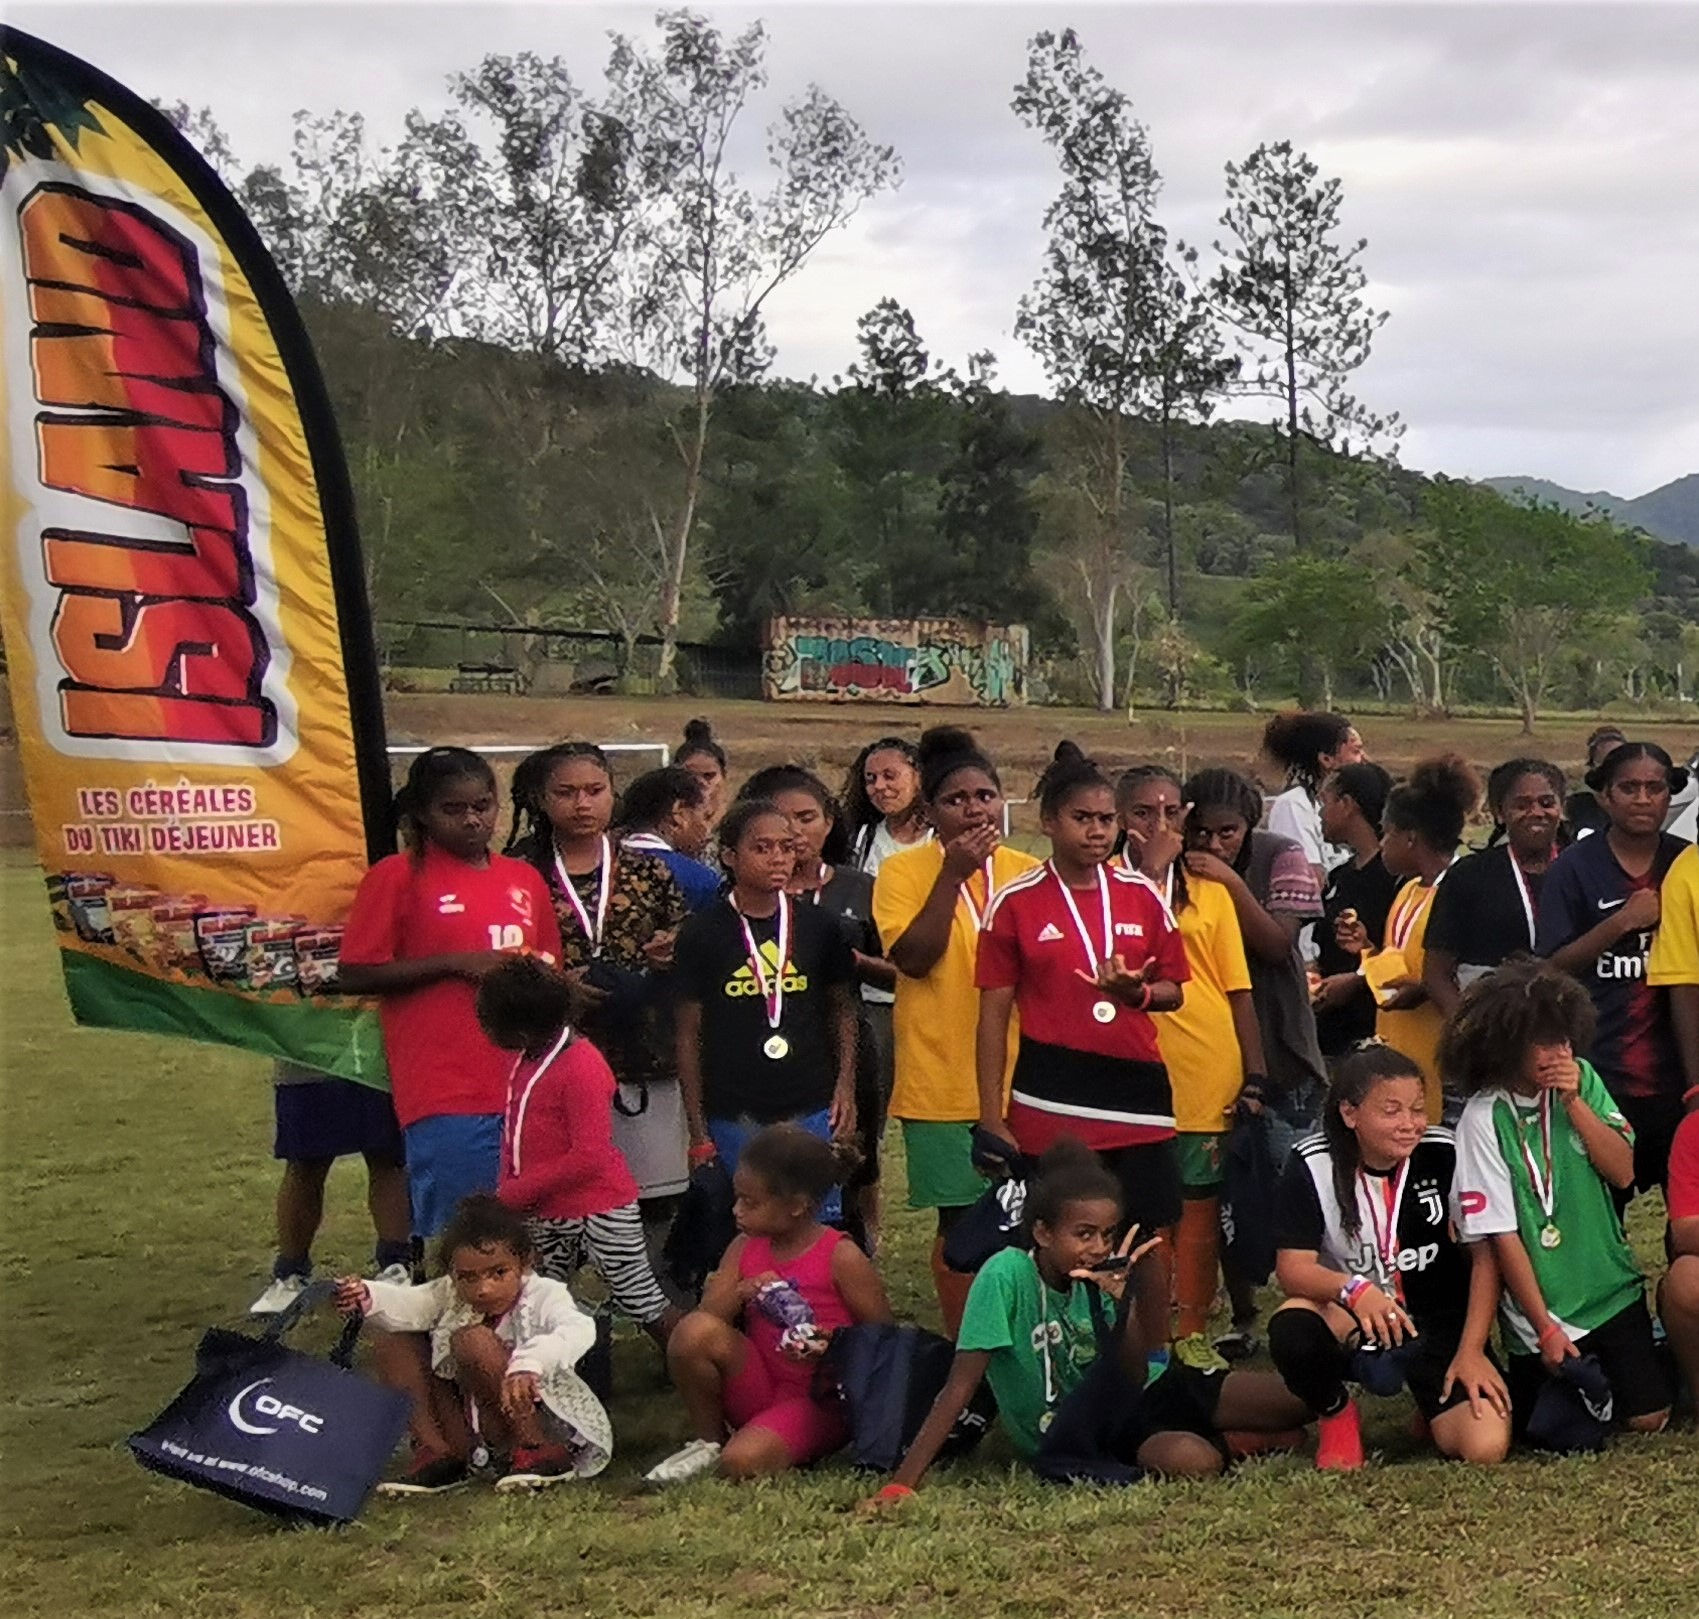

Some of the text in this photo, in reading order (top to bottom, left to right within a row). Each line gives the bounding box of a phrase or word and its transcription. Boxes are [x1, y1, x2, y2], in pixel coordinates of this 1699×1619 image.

[17, 180, 278, 753] ISLAND
[80, 780, 253, 816] LES CÉRÉALES
[65, 818, 278, 851] DU TIKI DÉJEUNER
[488, 924, 524, 950] 10
[725, 975, 808, 997] addas
[1347, 1243, 1438, 1273] Jep
[255, 1395, 324, 1434] OFC
